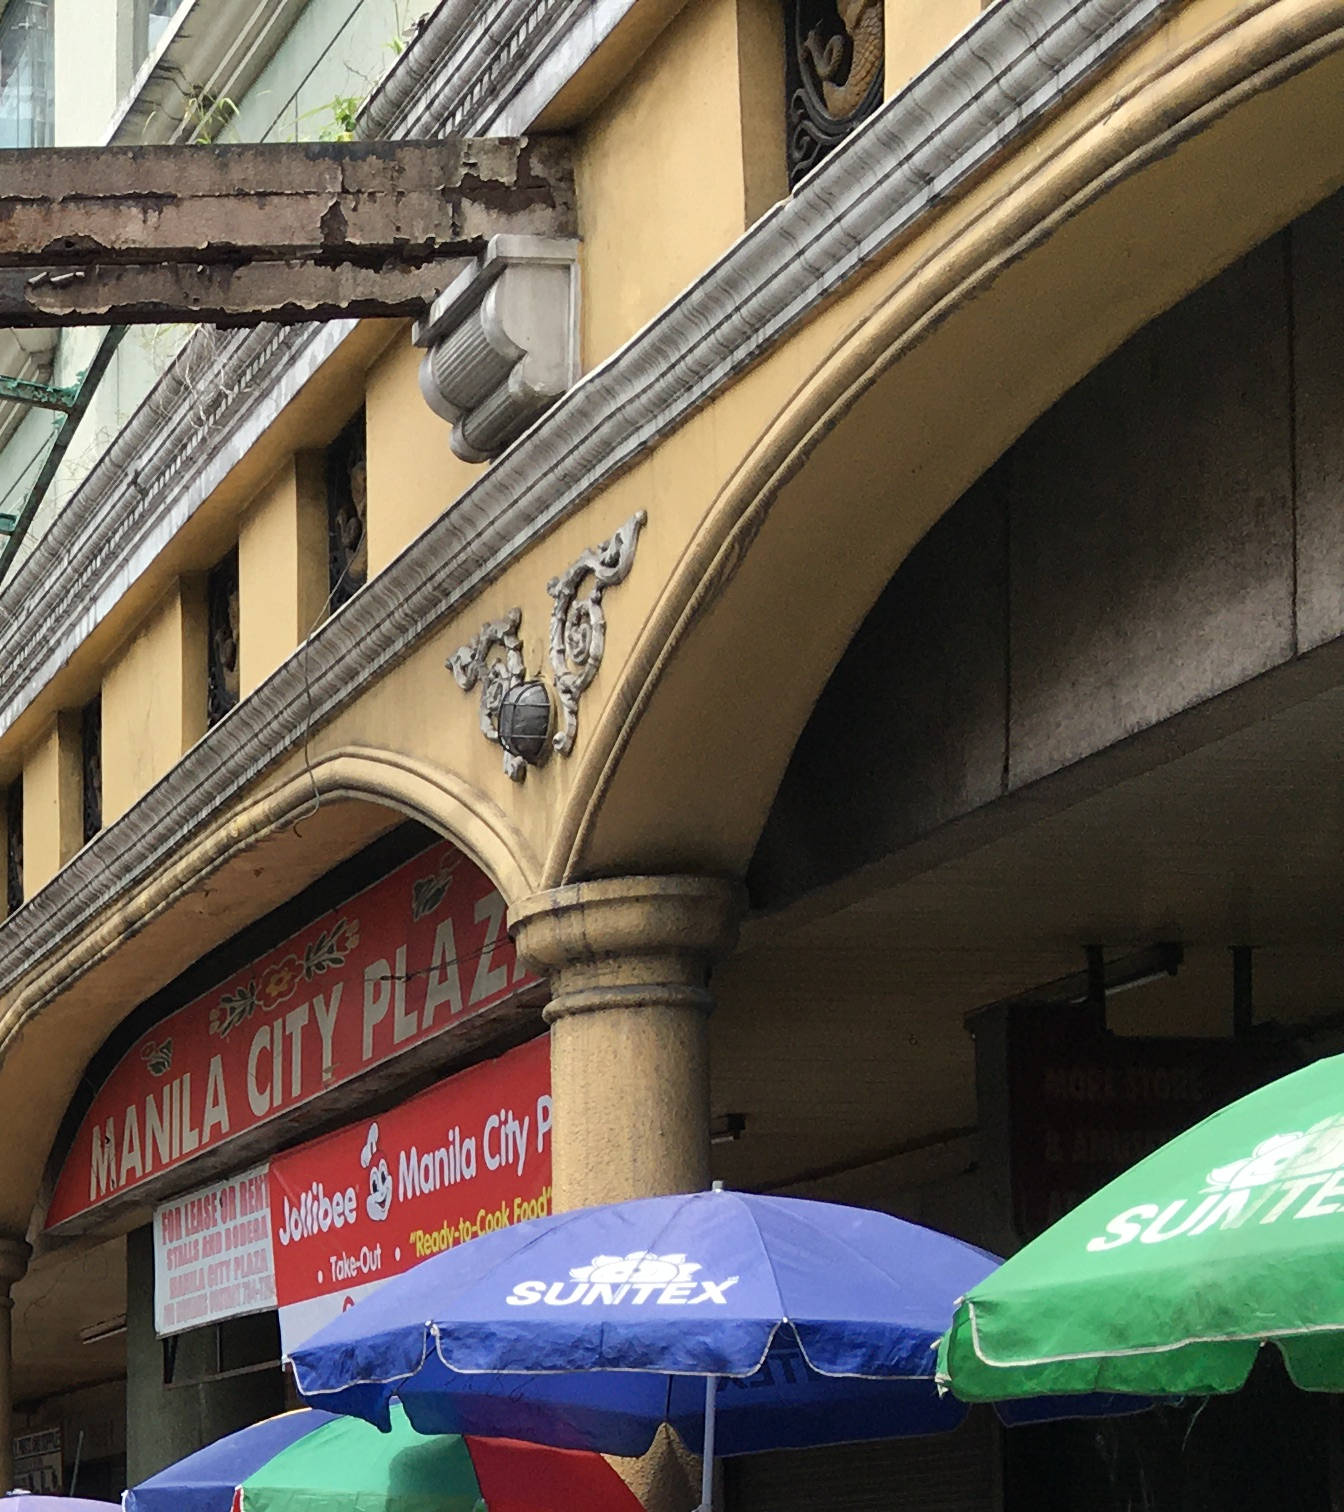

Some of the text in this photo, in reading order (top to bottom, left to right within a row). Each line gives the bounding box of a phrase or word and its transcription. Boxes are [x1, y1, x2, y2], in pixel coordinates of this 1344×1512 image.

[90, 896, 539, 1201] MANILA CITY PLAZ
[279, 1182, 357, 1246] Jollibee
[398, 1125, 477, 1202] Manila
[483, 1108, 529, 1176] City
[163, 1207, 181, 1245] FOR
[184, 1192, 218, 1237] LEASE
[220, 1186, 236, 1224] OR
[330, 1243, 381, 1282] Take-Out
[506, 1276, 739, 1306] SUNTEX
